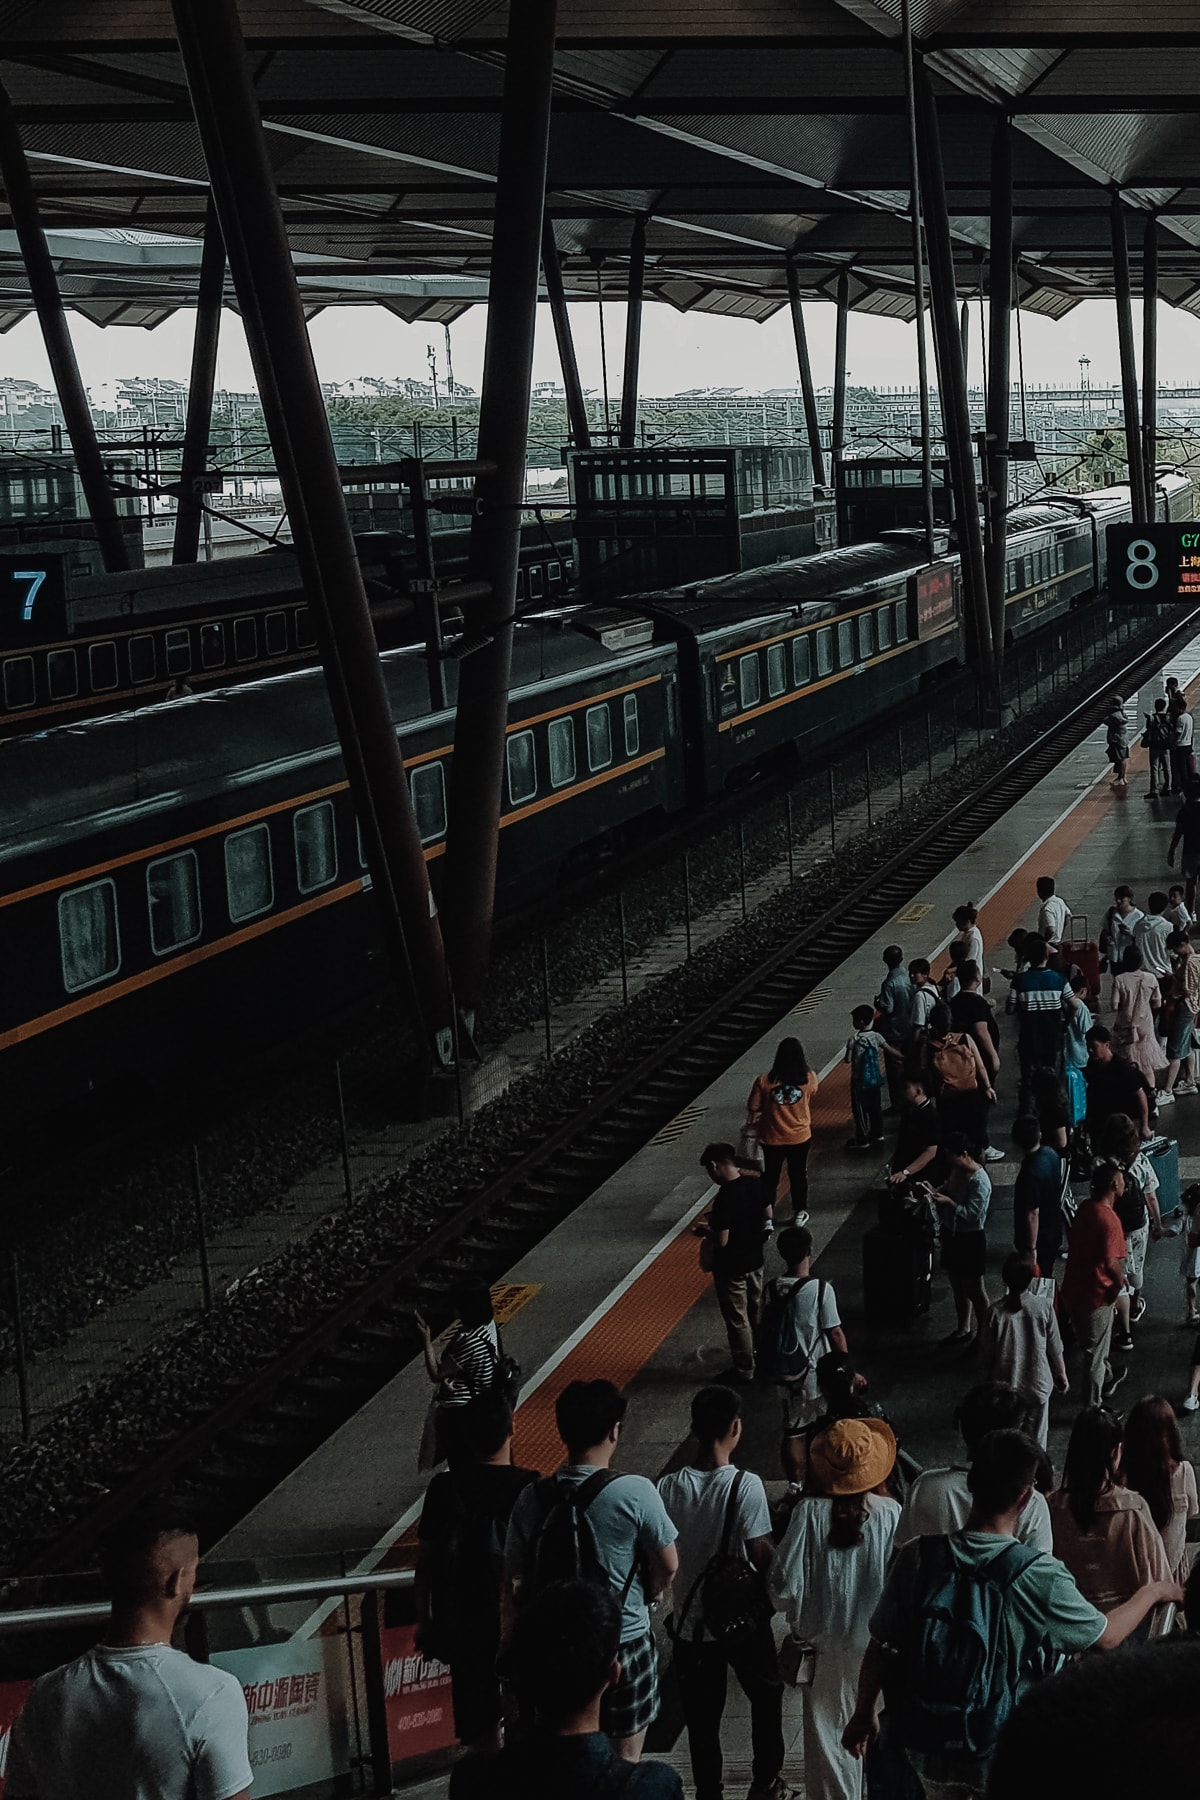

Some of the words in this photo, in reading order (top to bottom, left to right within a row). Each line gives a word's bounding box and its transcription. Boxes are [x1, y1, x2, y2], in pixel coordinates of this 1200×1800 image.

[1126, 539, 1159, 590] 8
[12, 570, 47, 621] 7
[243, 1671, 321, 1714] 新中源陶瓷
